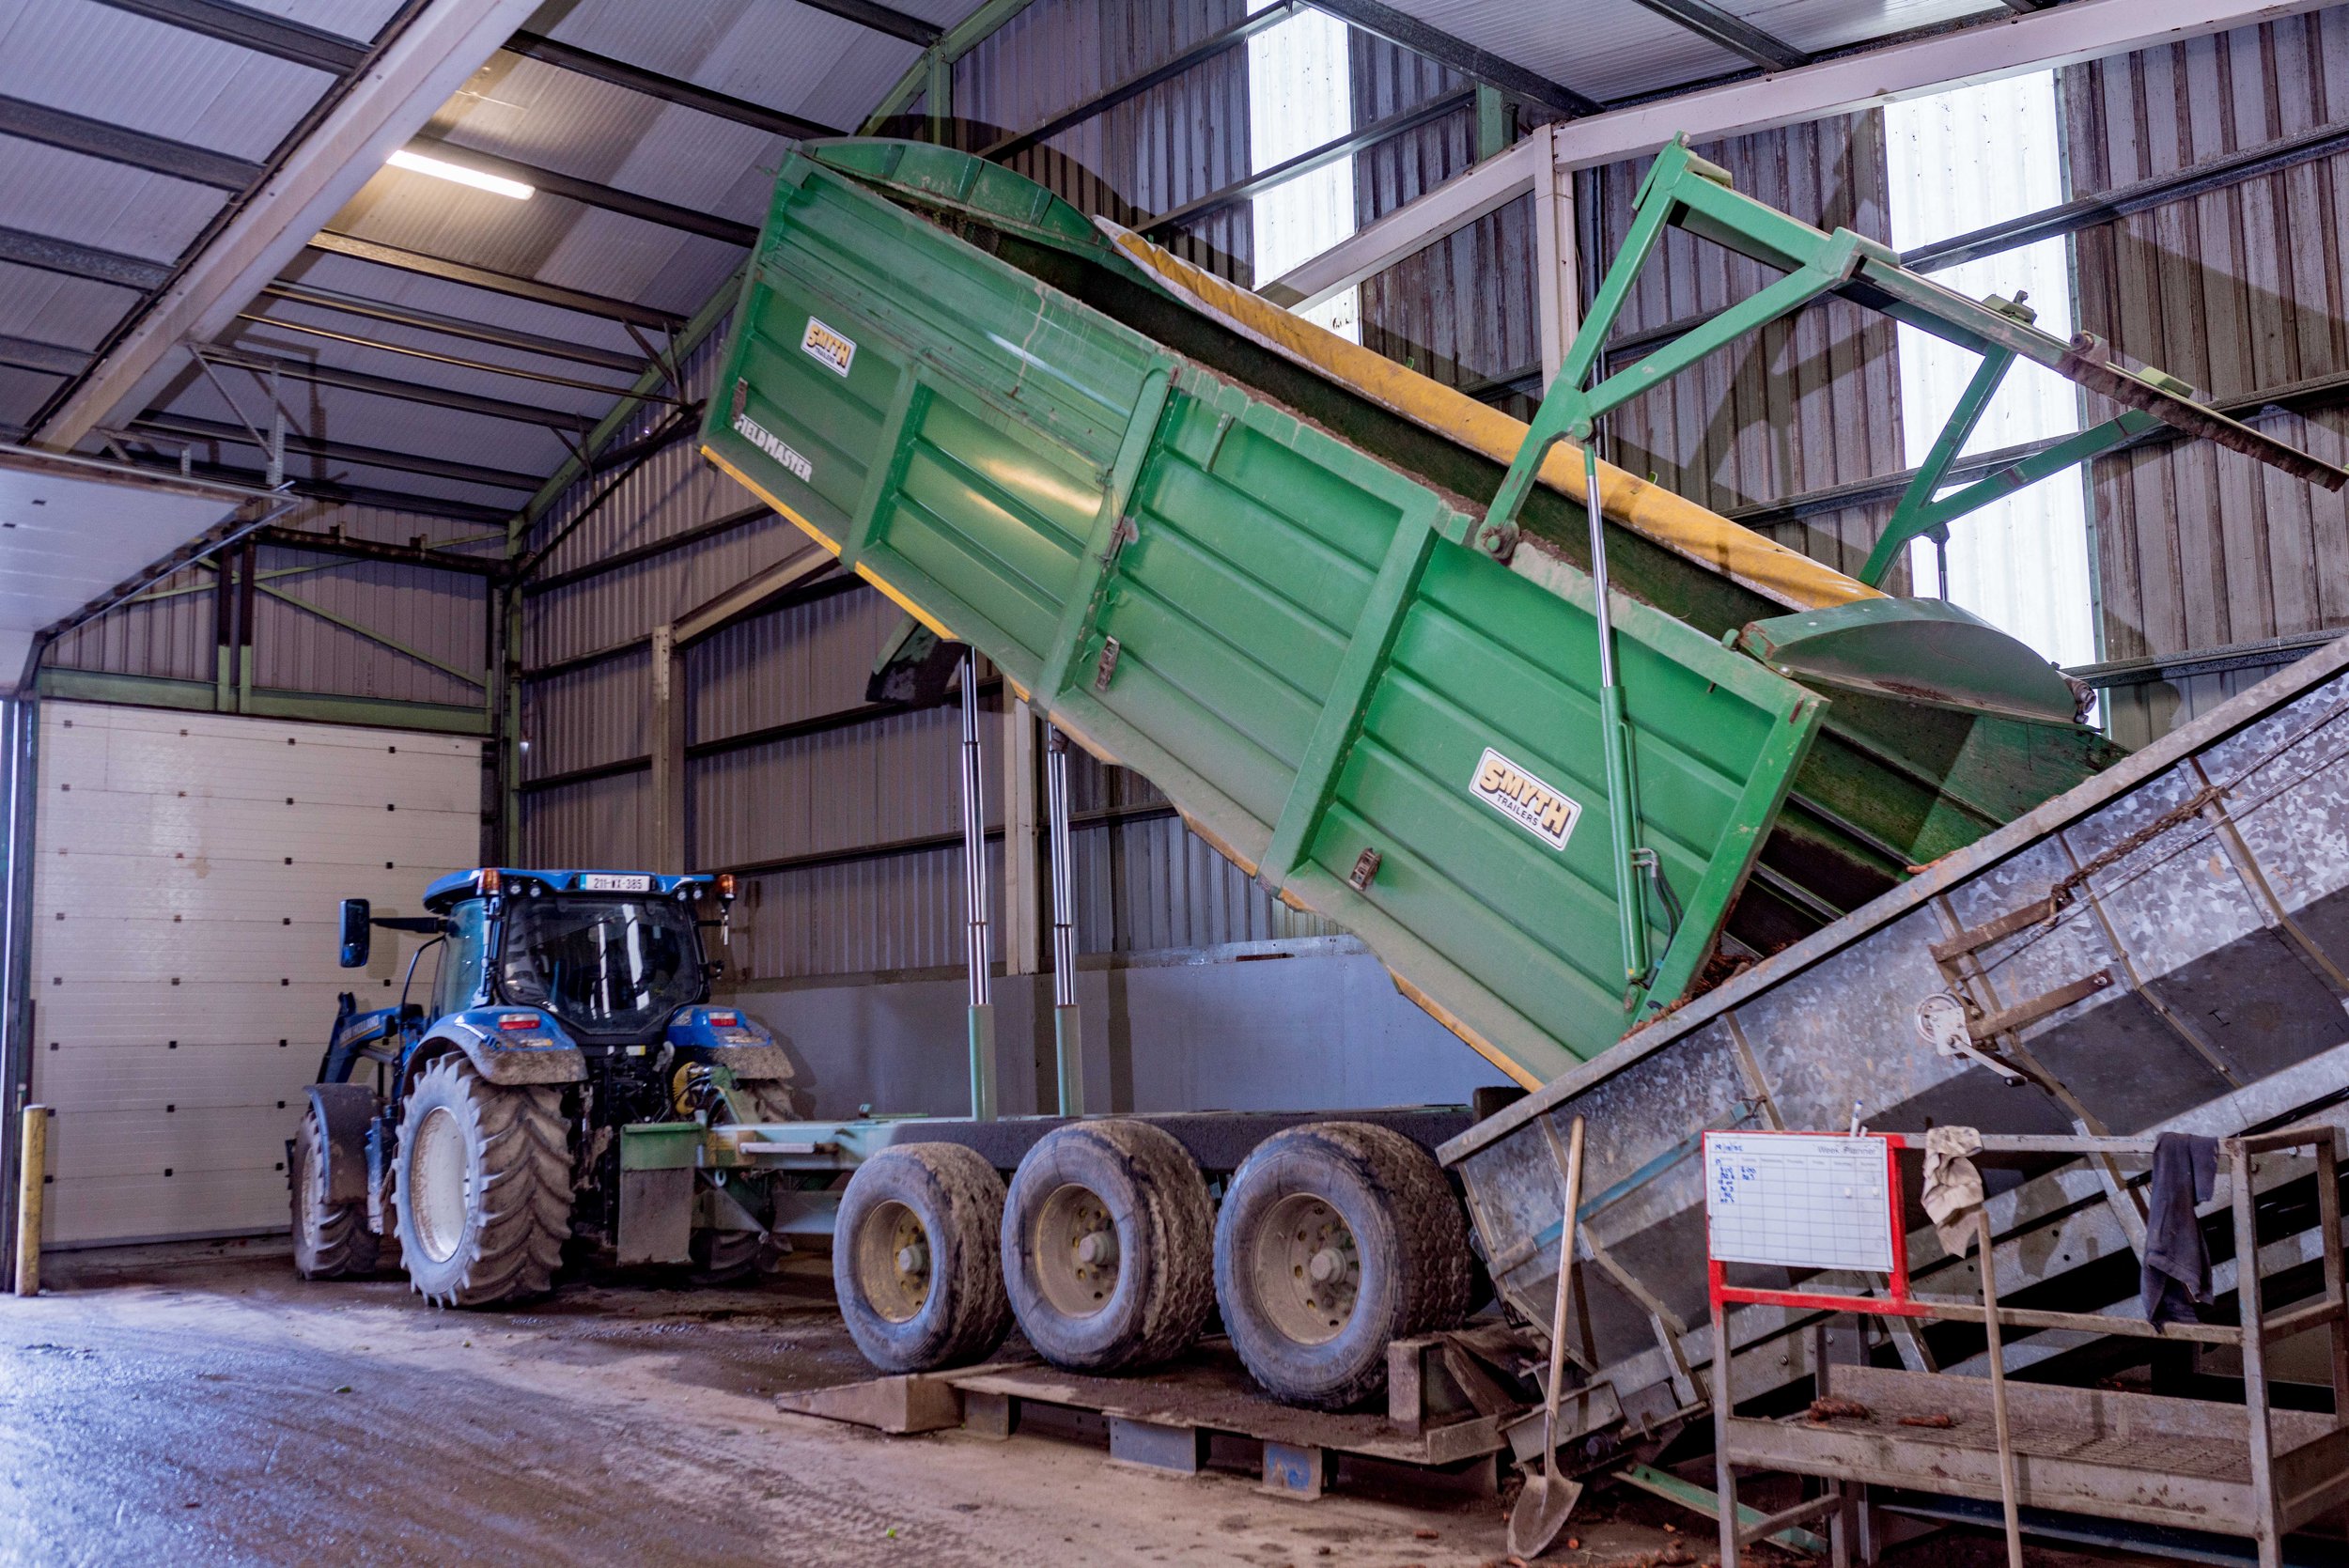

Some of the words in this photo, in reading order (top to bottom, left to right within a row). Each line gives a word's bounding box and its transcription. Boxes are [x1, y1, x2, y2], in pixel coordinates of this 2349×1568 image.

[806, 324, 851, 368] SMYTH
[1479, 759, 1571, 839] SMYTH
[1497, 794, 1538, 826] TRAILERS
[1817, 1145, 1840, 1155] Week
[1843, 1145, 1876, 1156] Planner
